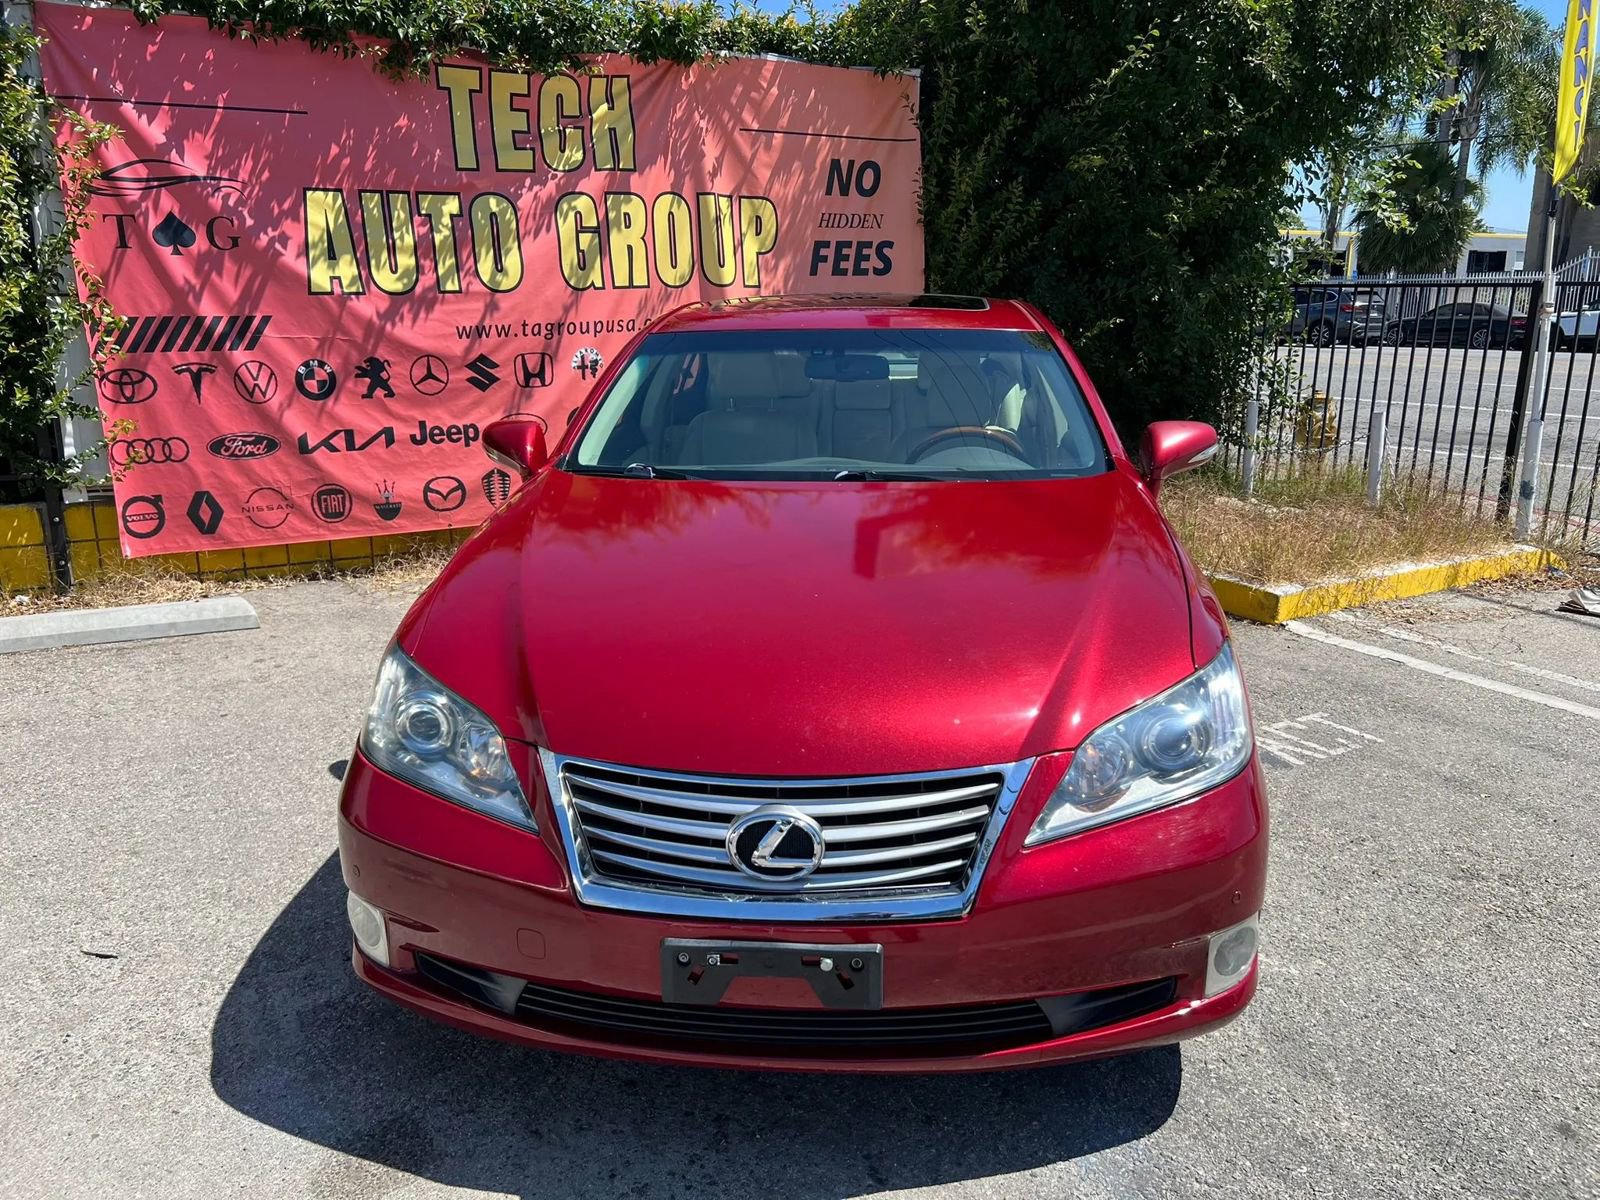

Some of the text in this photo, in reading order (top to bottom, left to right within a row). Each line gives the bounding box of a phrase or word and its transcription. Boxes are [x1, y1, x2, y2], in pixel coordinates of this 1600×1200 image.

[435, 63, 637, 173] TECH
[825, 158, 882, 197] NO
[102, 213, 241, 251] T G
[817, 212, 884, 230] HIDDEN
[303, 187, 779, 296] AUTO GROUP
[809, 239, 895, 277] FEES
[297, 360, 333, 375] BMW
[220, 435, 268, 457] Ford
[297, 426, 396, 455] KIA
[409, 420, 480, 448] Jeep
[126, 513, 159, 522] VOLVO
[241, 503, 295, 514] NISSAN
[320, 493, 345, 515] FIAT
